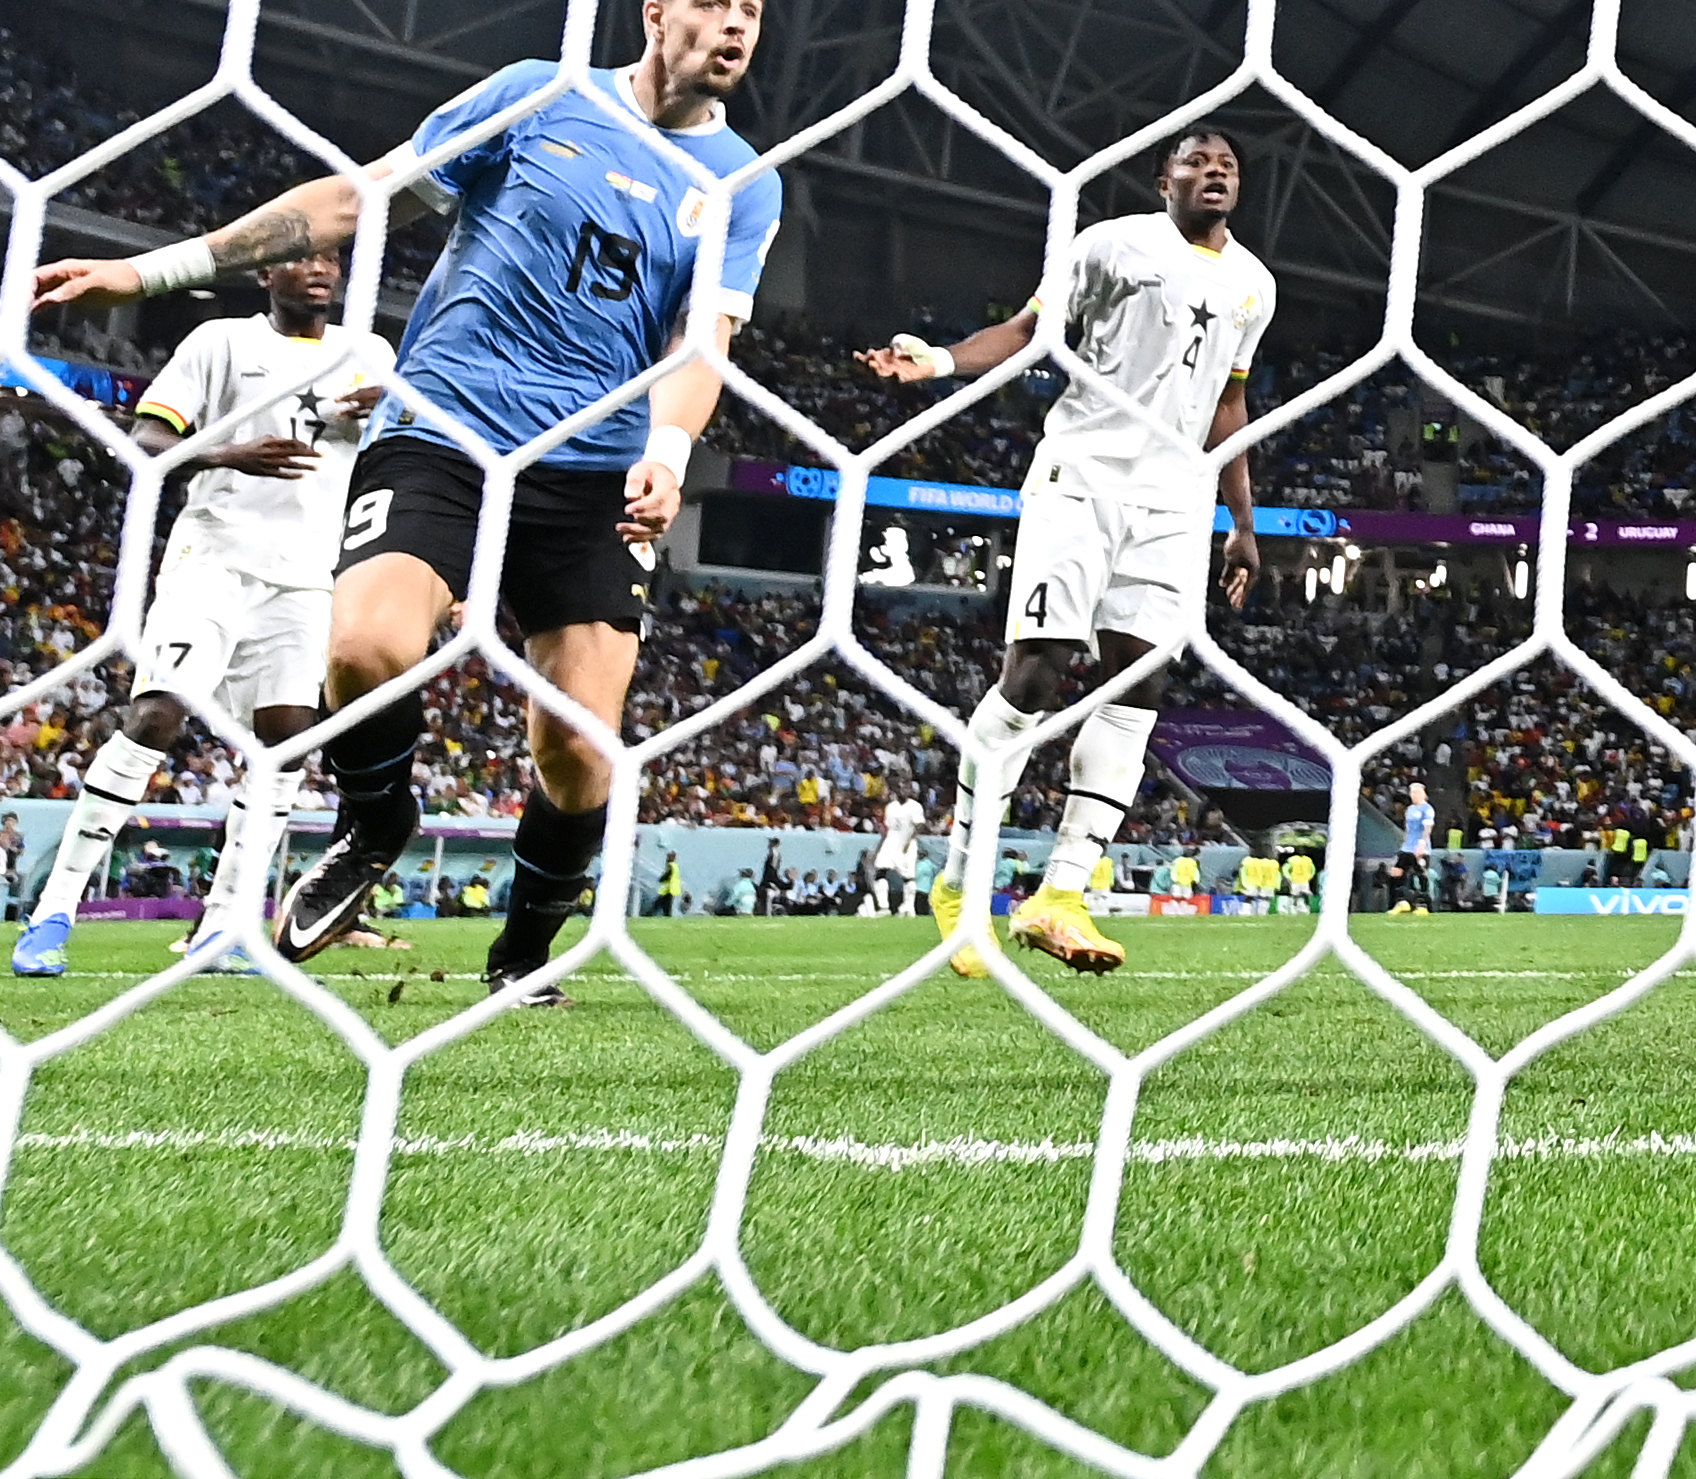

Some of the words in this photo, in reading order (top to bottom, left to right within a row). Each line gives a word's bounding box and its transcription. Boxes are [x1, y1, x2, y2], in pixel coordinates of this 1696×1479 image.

[566, 221, 642, 302] 19
[1182, 335, 1203, 380] 4
[1617, 525, 1679, 540] URUGUAY
[1025, 582, 1048, 628] 4
[1589, 887, 1690, 914] vivo
